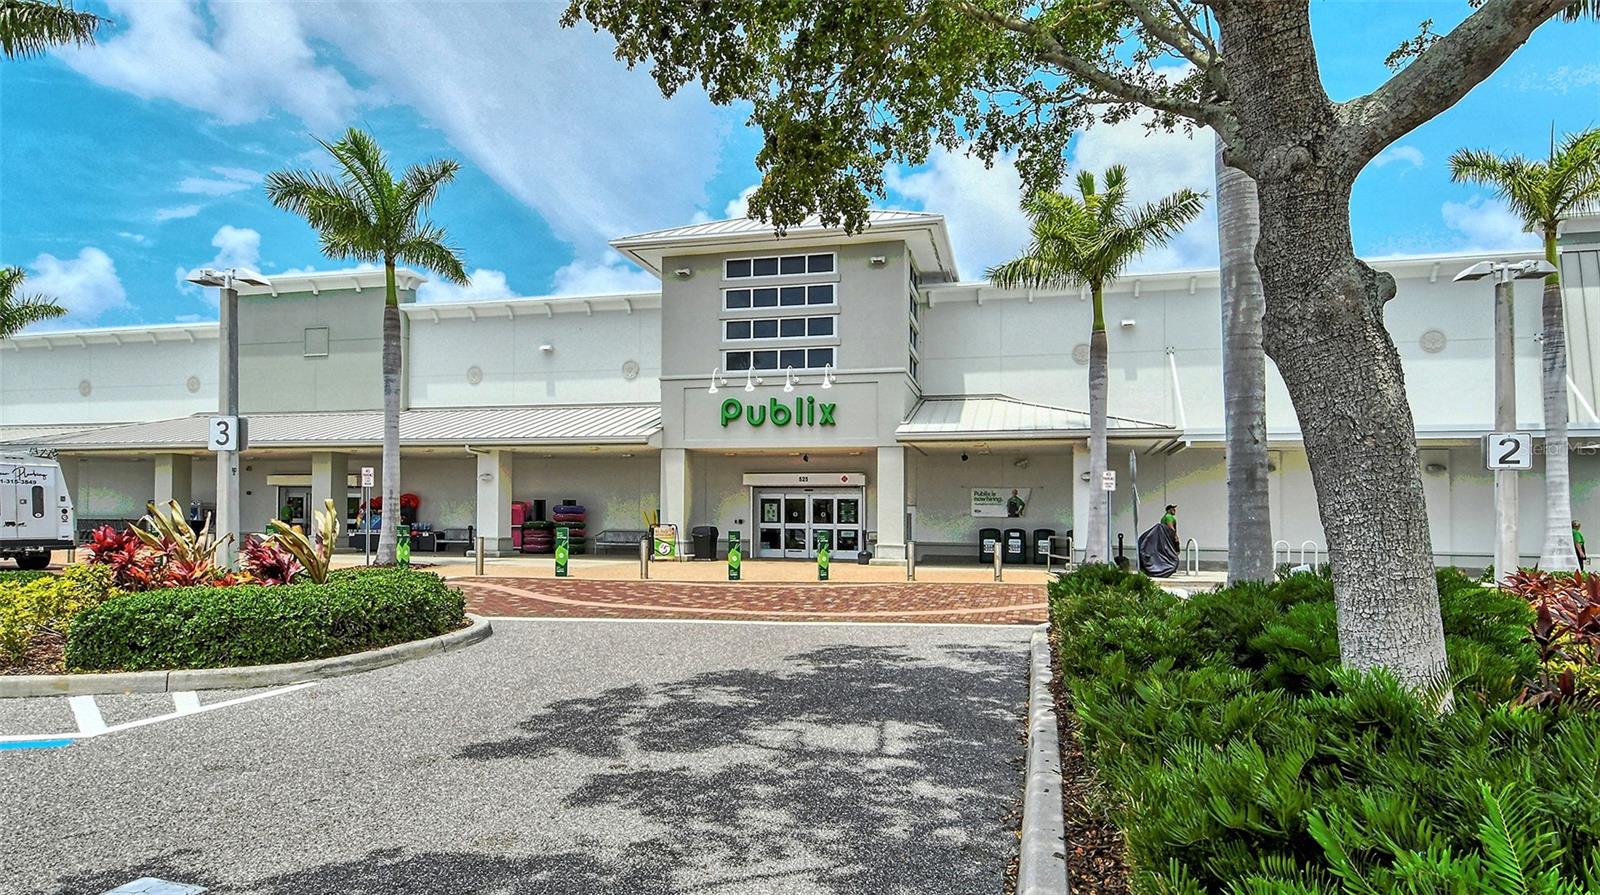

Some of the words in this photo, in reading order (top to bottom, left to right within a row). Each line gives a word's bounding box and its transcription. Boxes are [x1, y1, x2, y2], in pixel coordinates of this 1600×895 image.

[720, 395, 836, 427] Publix
[215, 420, 230, 446] 3
[1498, 438, 1520, 464] 2
